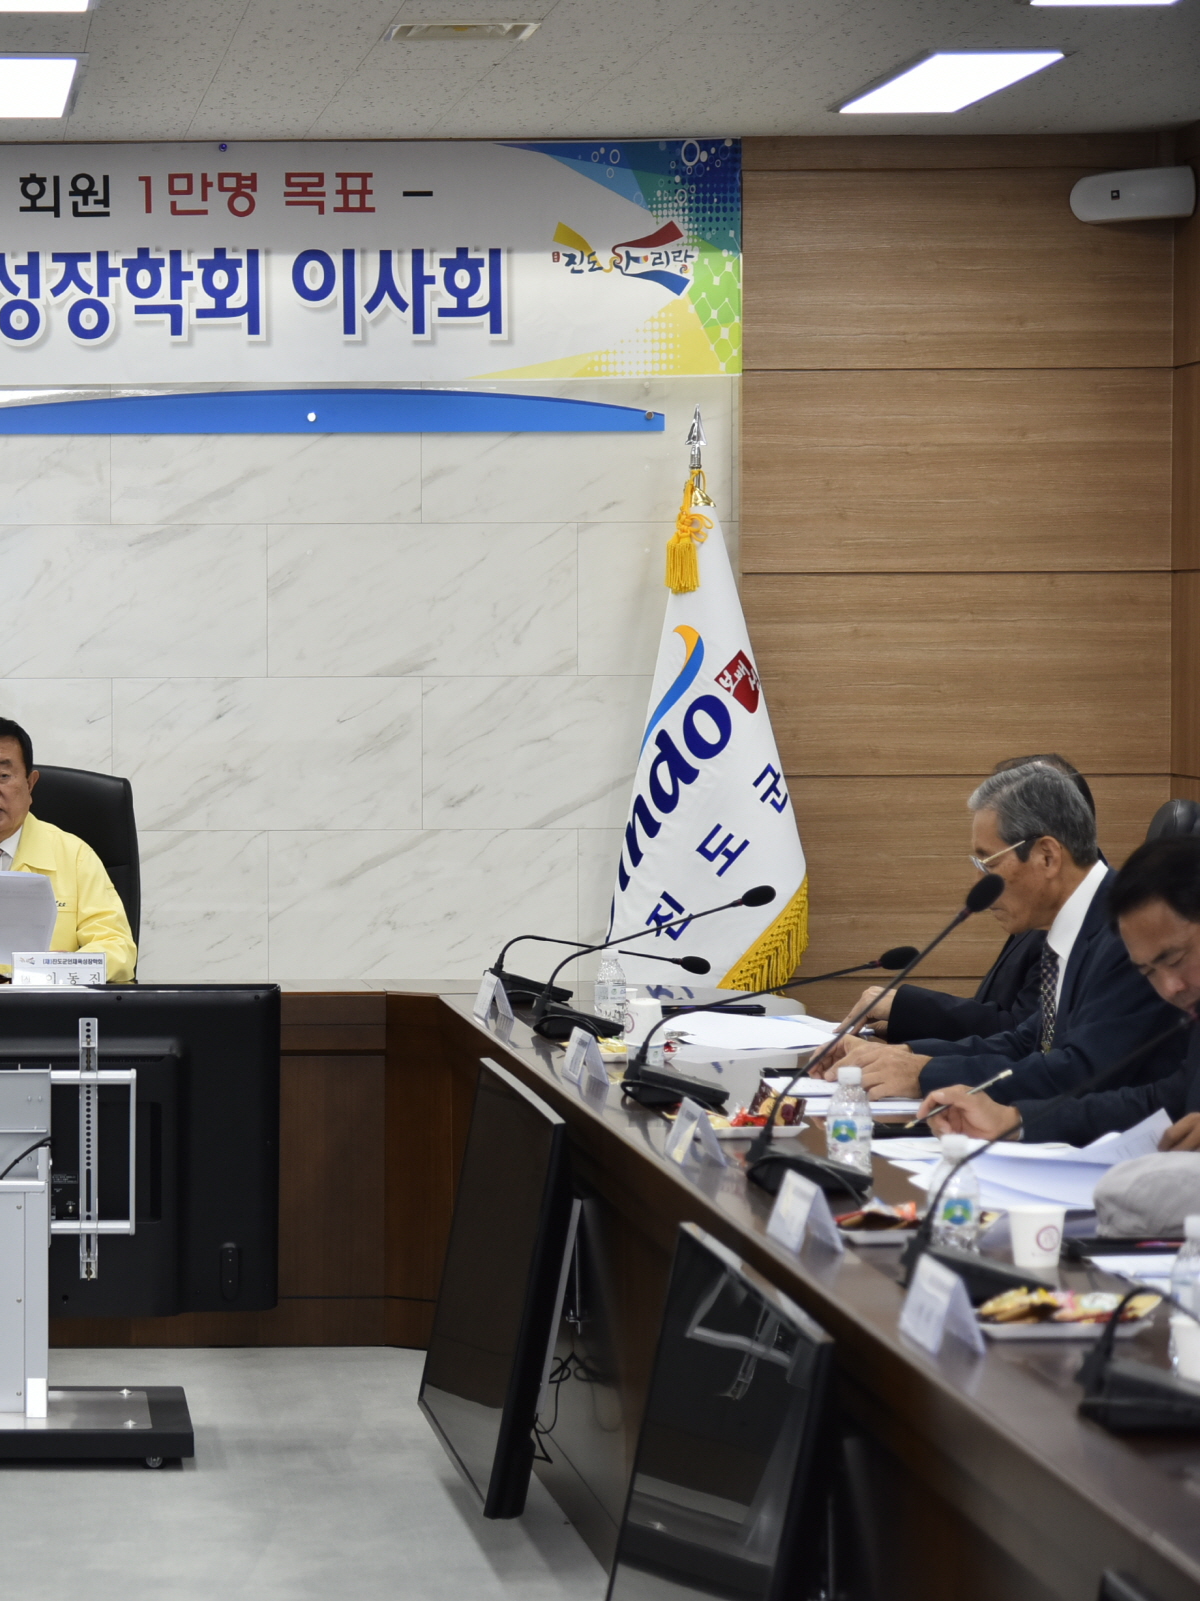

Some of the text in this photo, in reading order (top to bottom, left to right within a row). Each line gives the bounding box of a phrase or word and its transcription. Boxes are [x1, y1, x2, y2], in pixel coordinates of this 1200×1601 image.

[19, 172, 113, 220] 회원
[137, 172, 259, 218] 1만명
[283, 172, 377, 217] 목표
[291, 247, 504, 337] 이사회
[562, 250, 603, 274] 진도
[605, 694, 733, 944] indo
